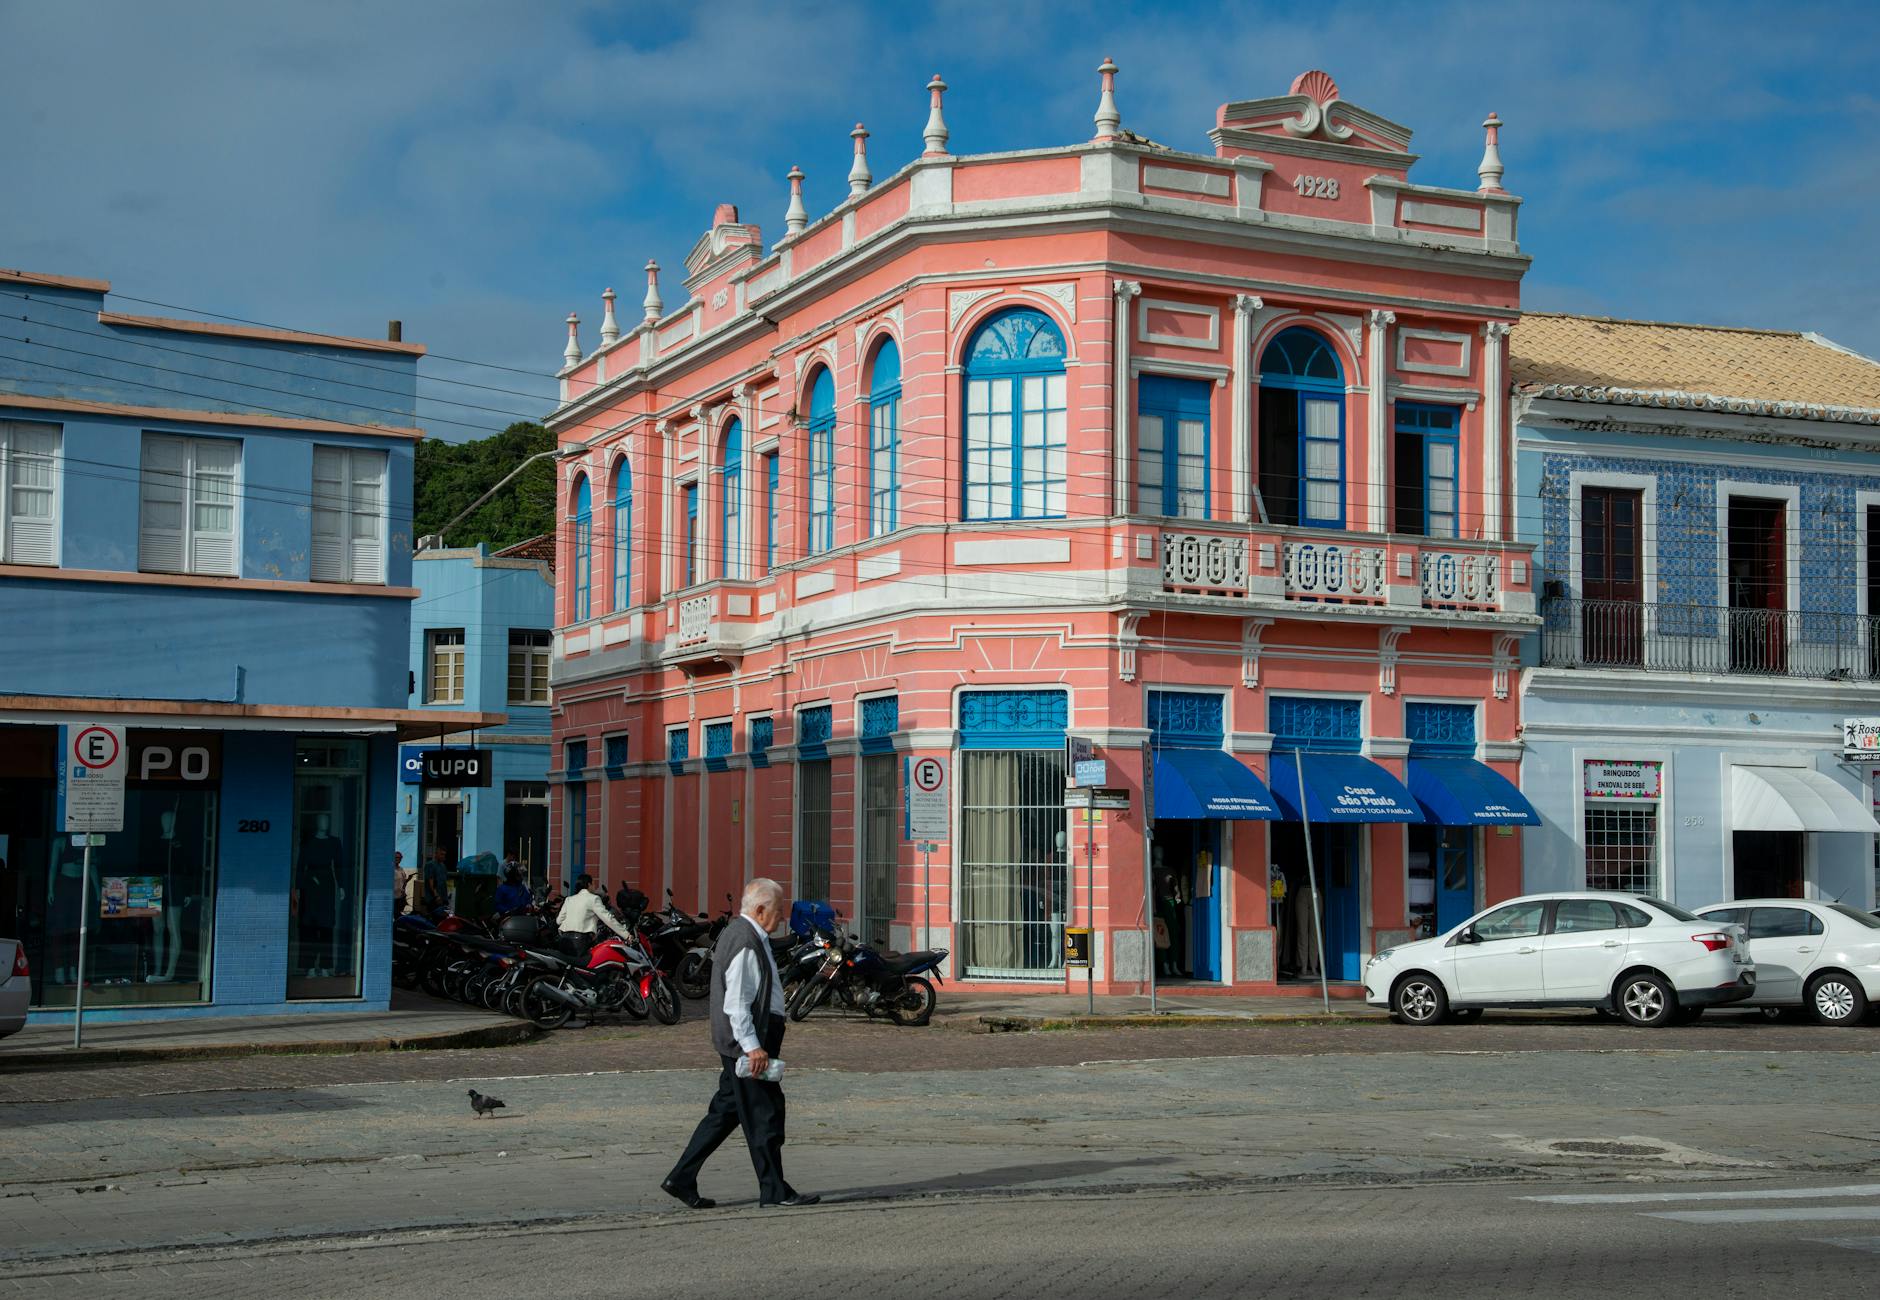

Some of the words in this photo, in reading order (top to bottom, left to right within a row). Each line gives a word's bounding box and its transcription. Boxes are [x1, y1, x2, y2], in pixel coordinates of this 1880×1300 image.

[1293, 174, 1339, 200] 1928
[89, 736, 105, 760] E
[429, 759, 479, 776] LUPO
[1603, 769, 1640, 777] BRINQUEDOS
[923, 765, 934, 784] E
[1344, 786, 1376, 795] Casa
[1598, 781, 1622, 789] ENXOVAL
[1337, 795, 1361, 805] São
[1361, 796, 1396, 806] Paulo
[238, 820, 270, 833] 280
[1683, 815, 1705, 827] 258
